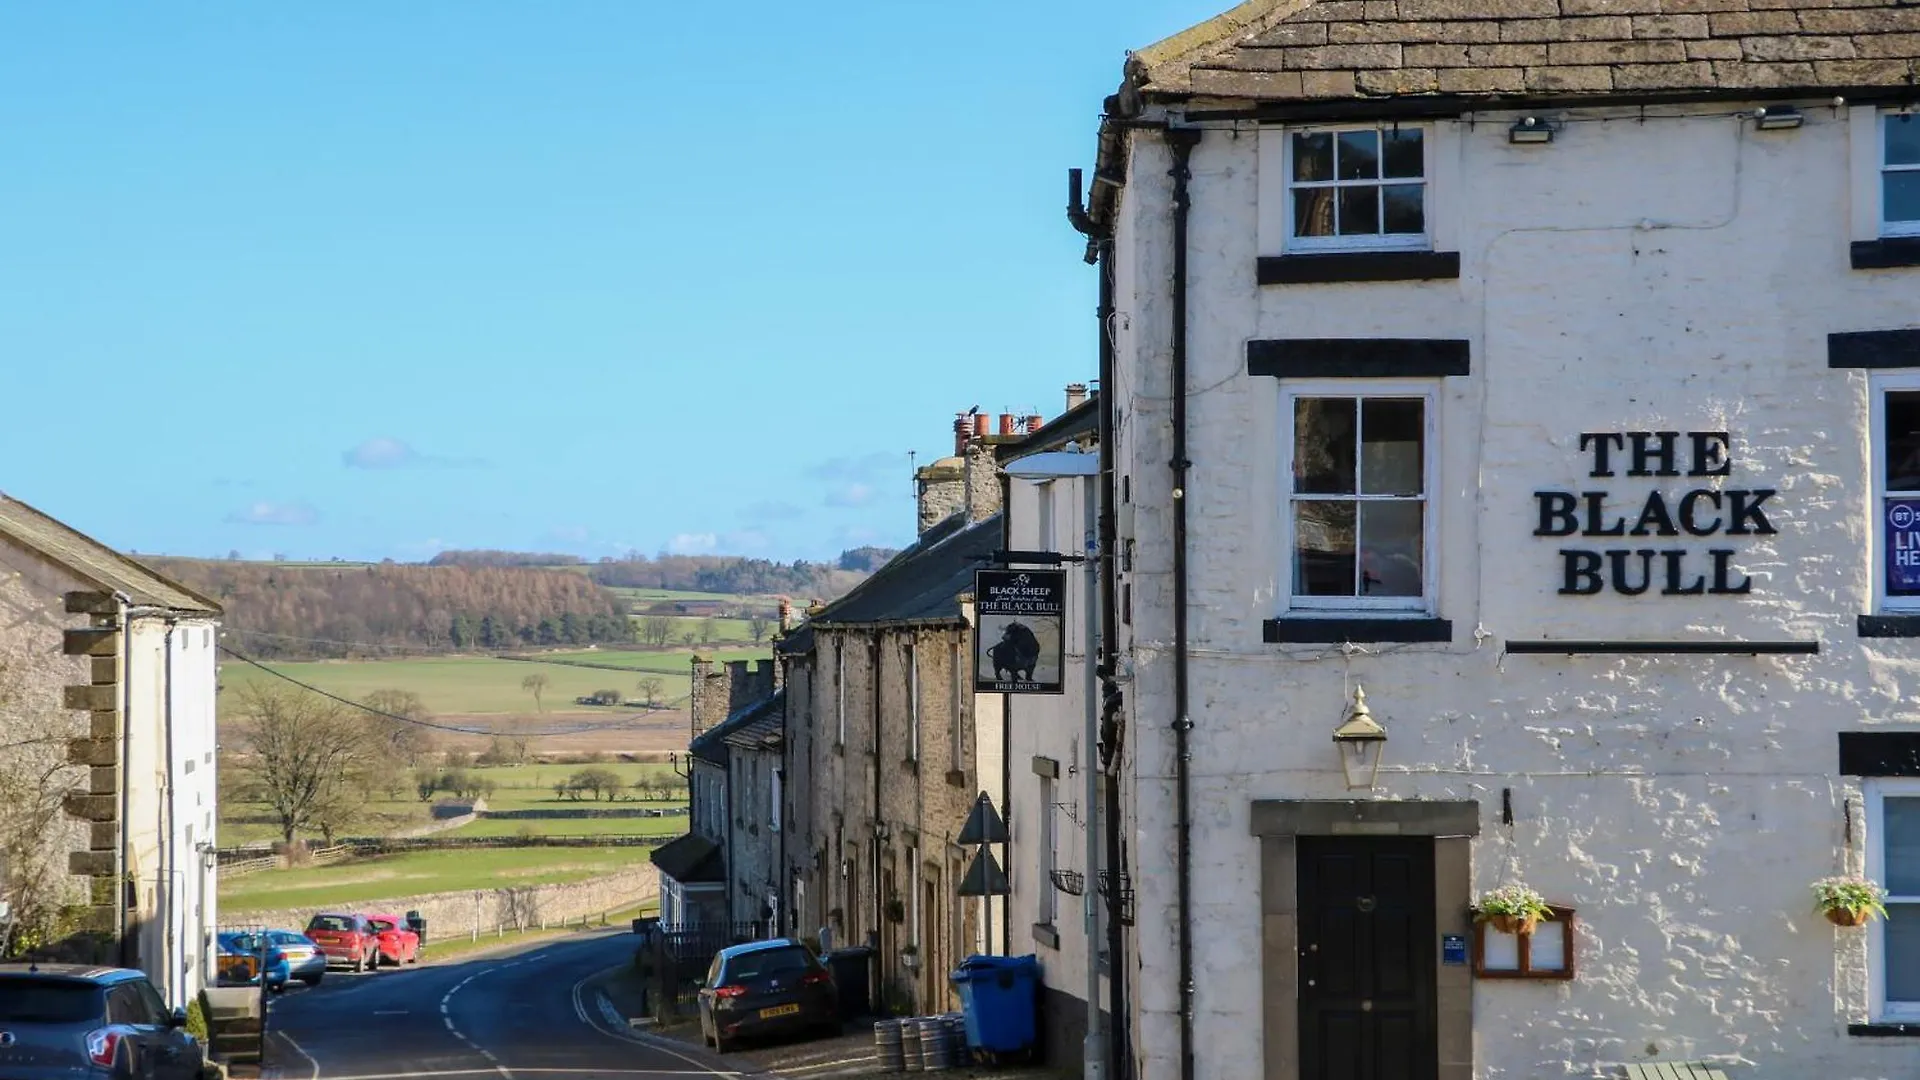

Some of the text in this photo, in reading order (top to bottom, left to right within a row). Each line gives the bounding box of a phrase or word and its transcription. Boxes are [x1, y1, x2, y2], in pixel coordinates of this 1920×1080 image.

[1580, 431, 1731, 477] THE
[1533, 489, 1778, 536] BLACK
[1895, 512, 1909, 521] BT
[1895, 550, 1920, 566] HE
[1558, 549, 1751, 595] BULL
[990, 586, 1051, 596] BLACK SHEEP
[980, 601, 1060, 611] THE BLACK BULL
[995, 682, 1013, 690] FREE
